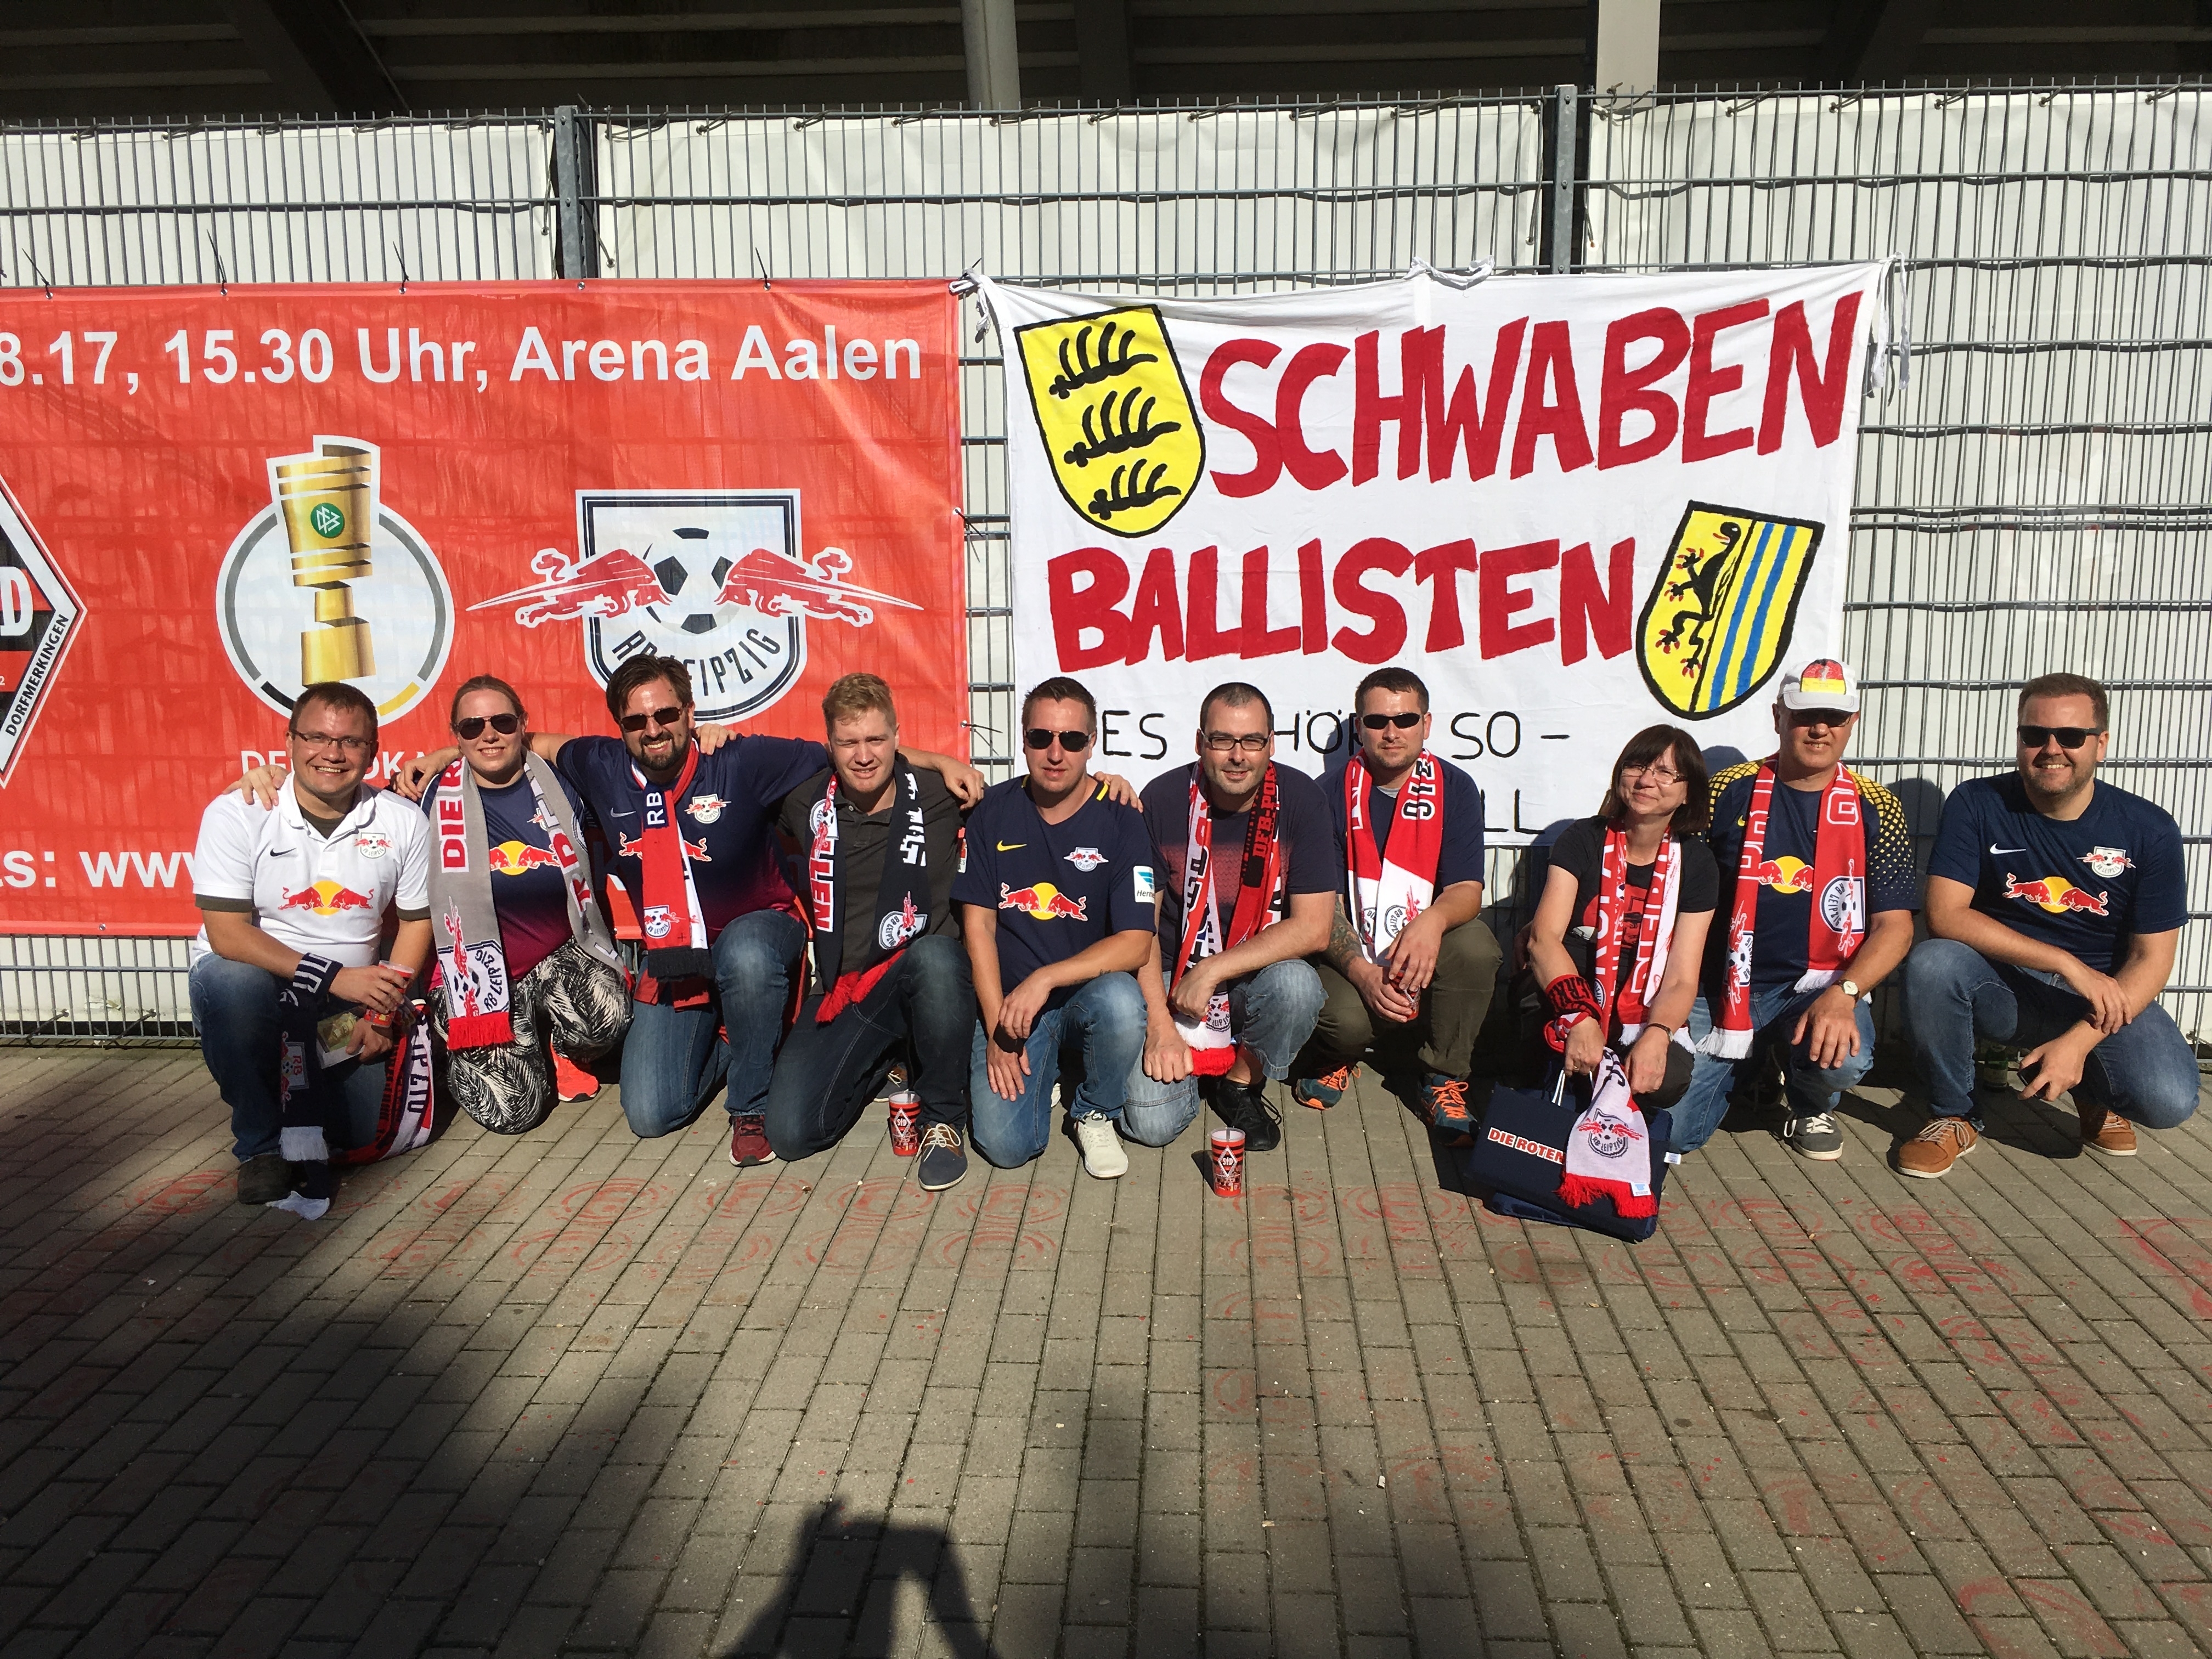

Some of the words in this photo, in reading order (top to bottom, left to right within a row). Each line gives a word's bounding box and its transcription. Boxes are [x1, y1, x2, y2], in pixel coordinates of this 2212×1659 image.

[0, 331, 139, 394] 8.17,
[165, 328, 334, 384] 15.30
[358, 328, 488, 393] Uhr,
[509, 326, 710, 381] Arena
[731, 325, 921, 380] Aalen
[1199, 291, 1863, 498] SCHWABEN
[1048, 537, 1634, 672] BALLISTEN
[5, 614, 69, 736] DORFMERKINGEN
[1102, 710, 1167, 760] ES
[1451, 711, 1521, 760] SO
[646, 792, 665, 825] RB
[1253, 760, 1276, 857] DFB-POK
[439, 799, 467, 868] DIE
[79, 851, 194, 888] ww
[1828, 894, 1842, 927] LEIPZIG
[885, 923, 896, 946] LEIPZIG
[475, 950, 503, 996] LEIPZIG
[484, 992, 498, 1011] RB
[1488, 1127, 1515, 1148] DIE
[1515, 1137, 1564, 1164] ROTEN
[1592, 1136, 1601, 1146] RB
[1601, 1137, 1623, 1152] LEIPZIG
